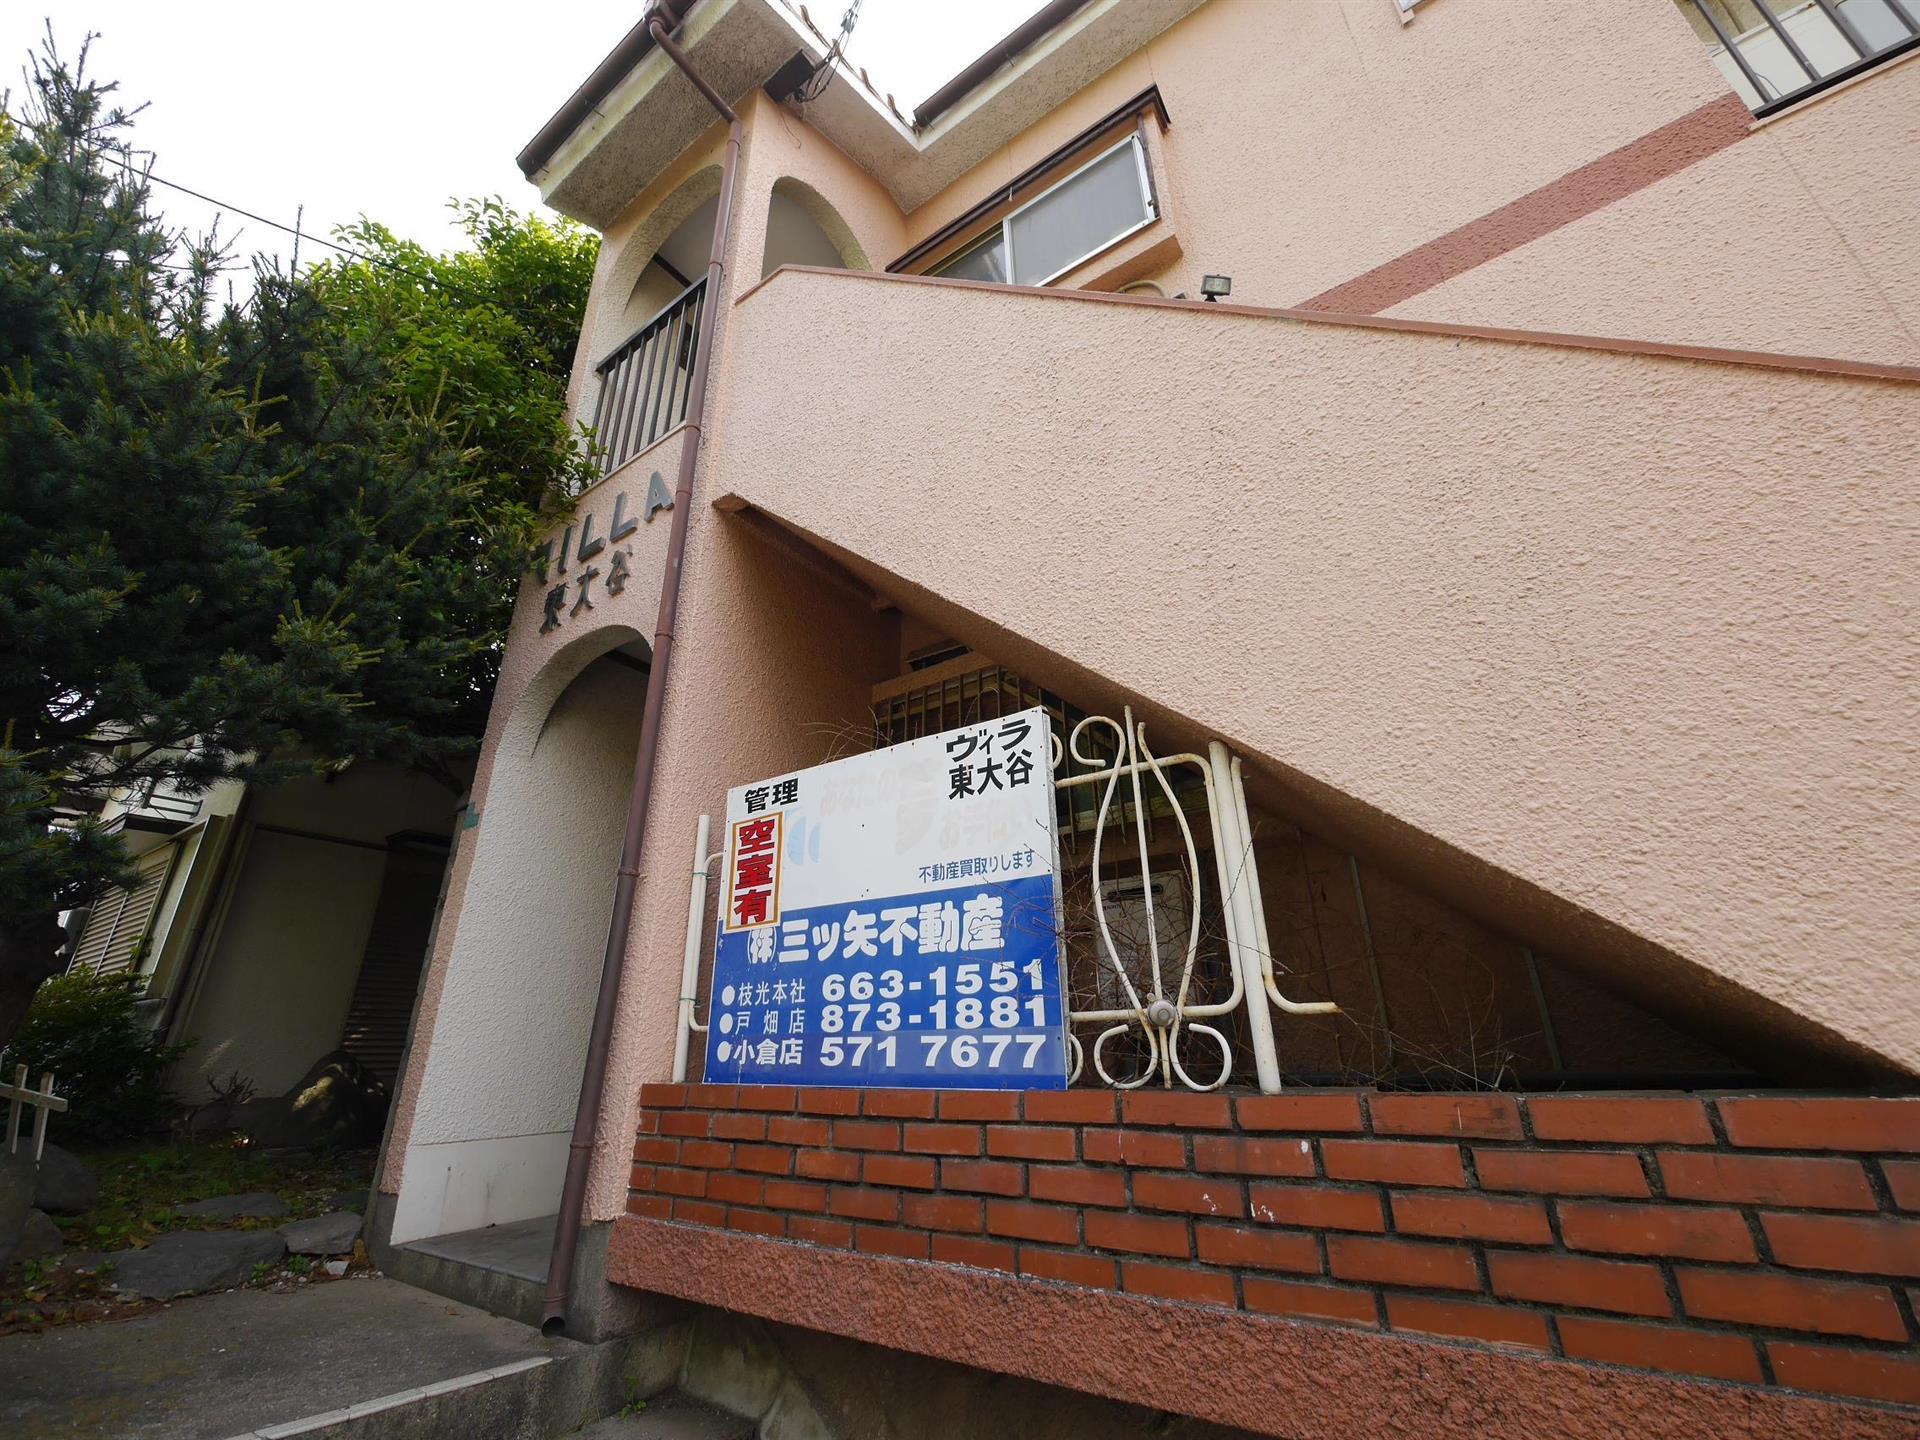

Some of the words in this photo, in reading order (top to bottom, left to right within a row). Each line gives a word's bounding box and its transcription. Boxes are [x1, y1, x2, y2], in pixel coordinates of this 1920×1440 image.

[539, 543, 634, 635] 東大谷
[946, 718, 1032, 762] ヴィラ
[744, 778, 799, 814] 管理
[949, 749, 1034, 800] 東大谷
[734, 818, 775, 926] 空室有
[919, 849, 1035, 883] 不動産買取りします
[738, 978, 806, 1007] 枝光本社
[822, 958, 1045, 1002] 663-1551
[821, 996, 1046, 1034] 873-1881
[733, 1037, 803, 1066] 小倉店
[819, 1036, 897, 1067] 571
[920, 1034, 1046, 1069] 7677
